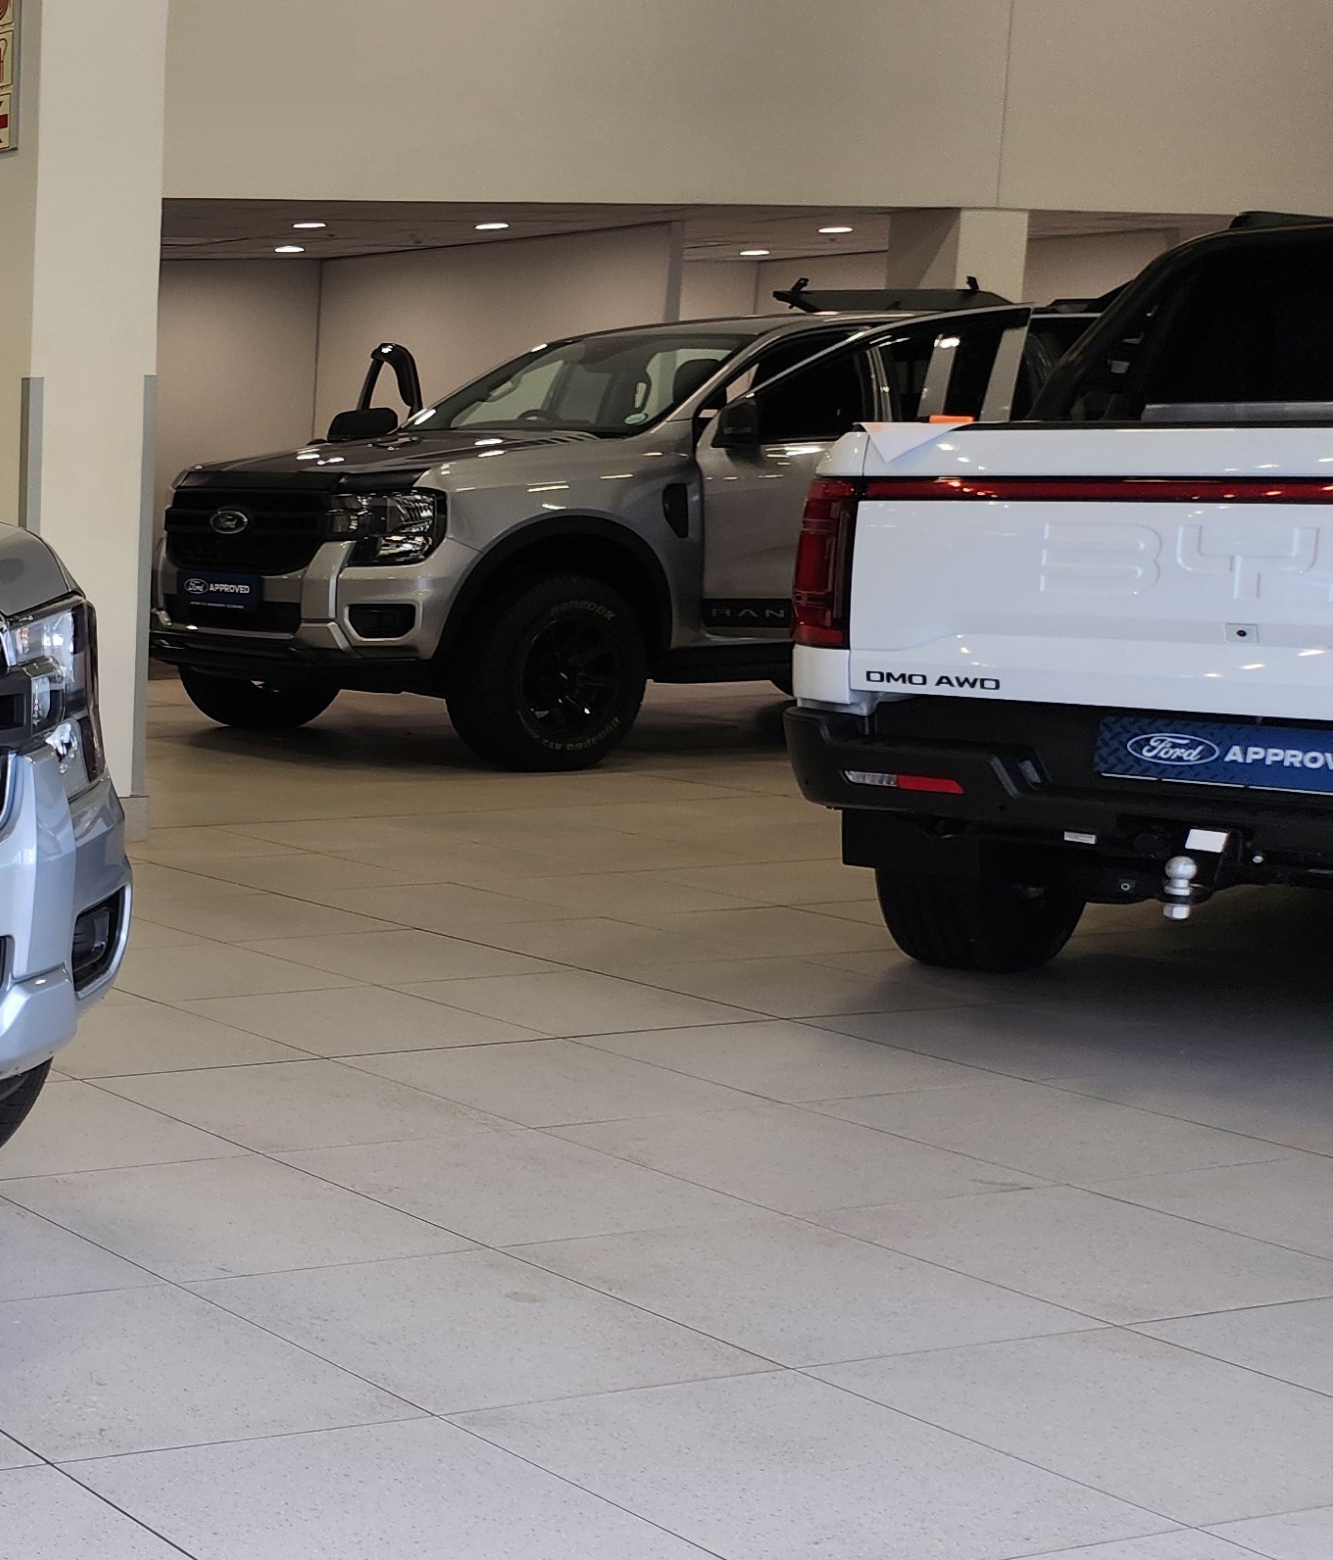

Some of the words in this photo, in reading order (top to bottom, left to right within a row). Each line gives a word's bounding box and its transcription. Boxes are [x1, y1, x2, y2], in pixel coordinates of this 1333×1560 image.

[1039, 522, 1333, 602] BY
[209, 583, 250, 594] APPROVED
[866, 670, 927, 686] DMO
[935, 675, 1000, 691] AWD
[1141, 735, 1203, 763] Ford
